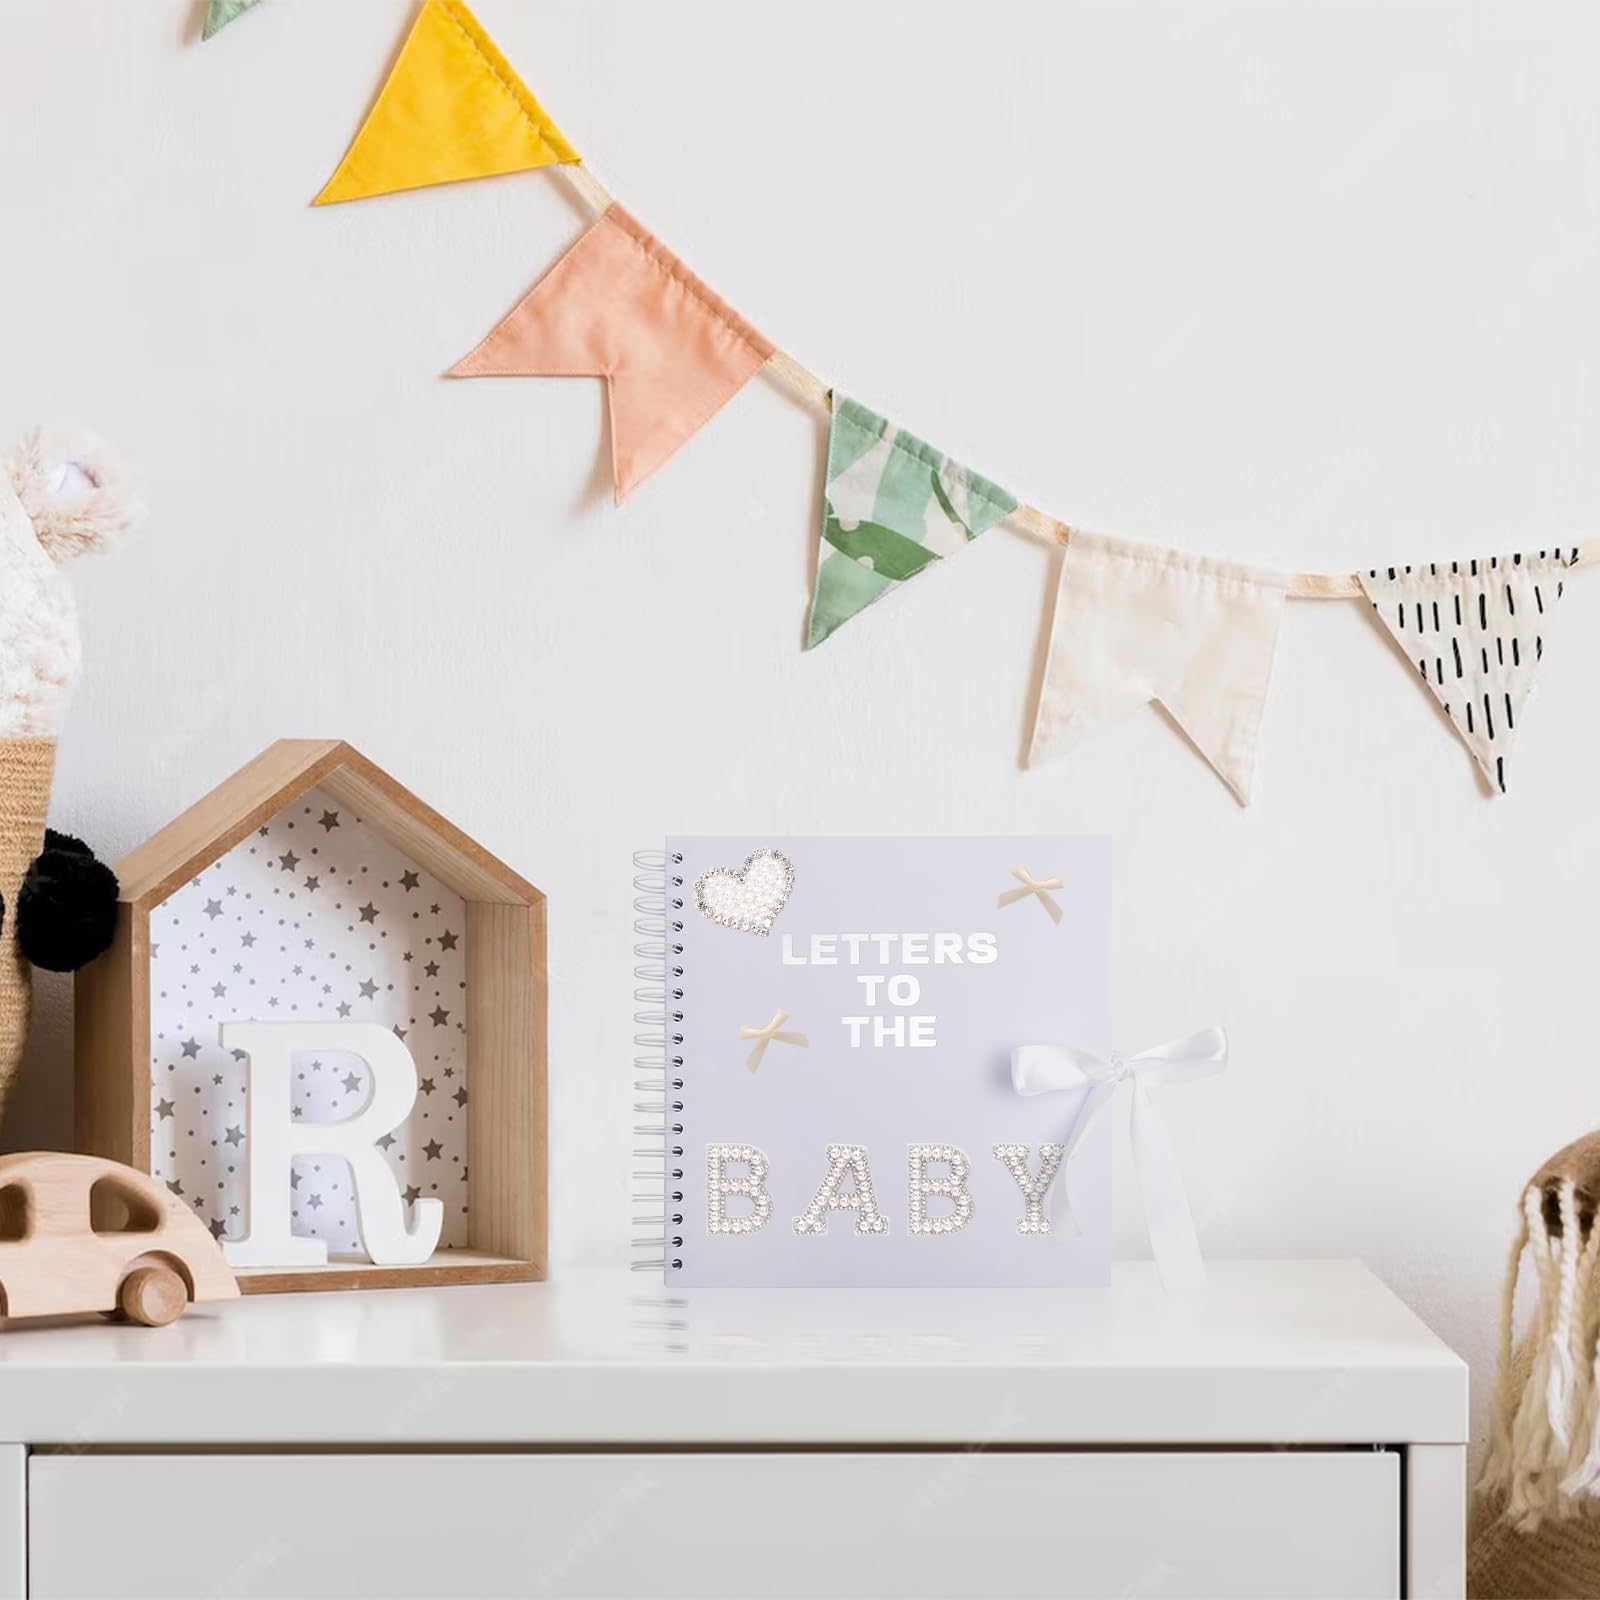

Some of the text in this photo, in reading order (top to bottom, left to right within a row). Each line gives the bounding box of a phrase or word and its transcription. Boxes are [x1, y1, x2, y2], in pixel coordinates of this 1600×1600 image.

[781, 932, 999, 965] LETTERS
[857, 974, 921, 1007] TO
[841, 1015, 937, 1048] THE
[705, 1143, 1066, 1237] BABY
